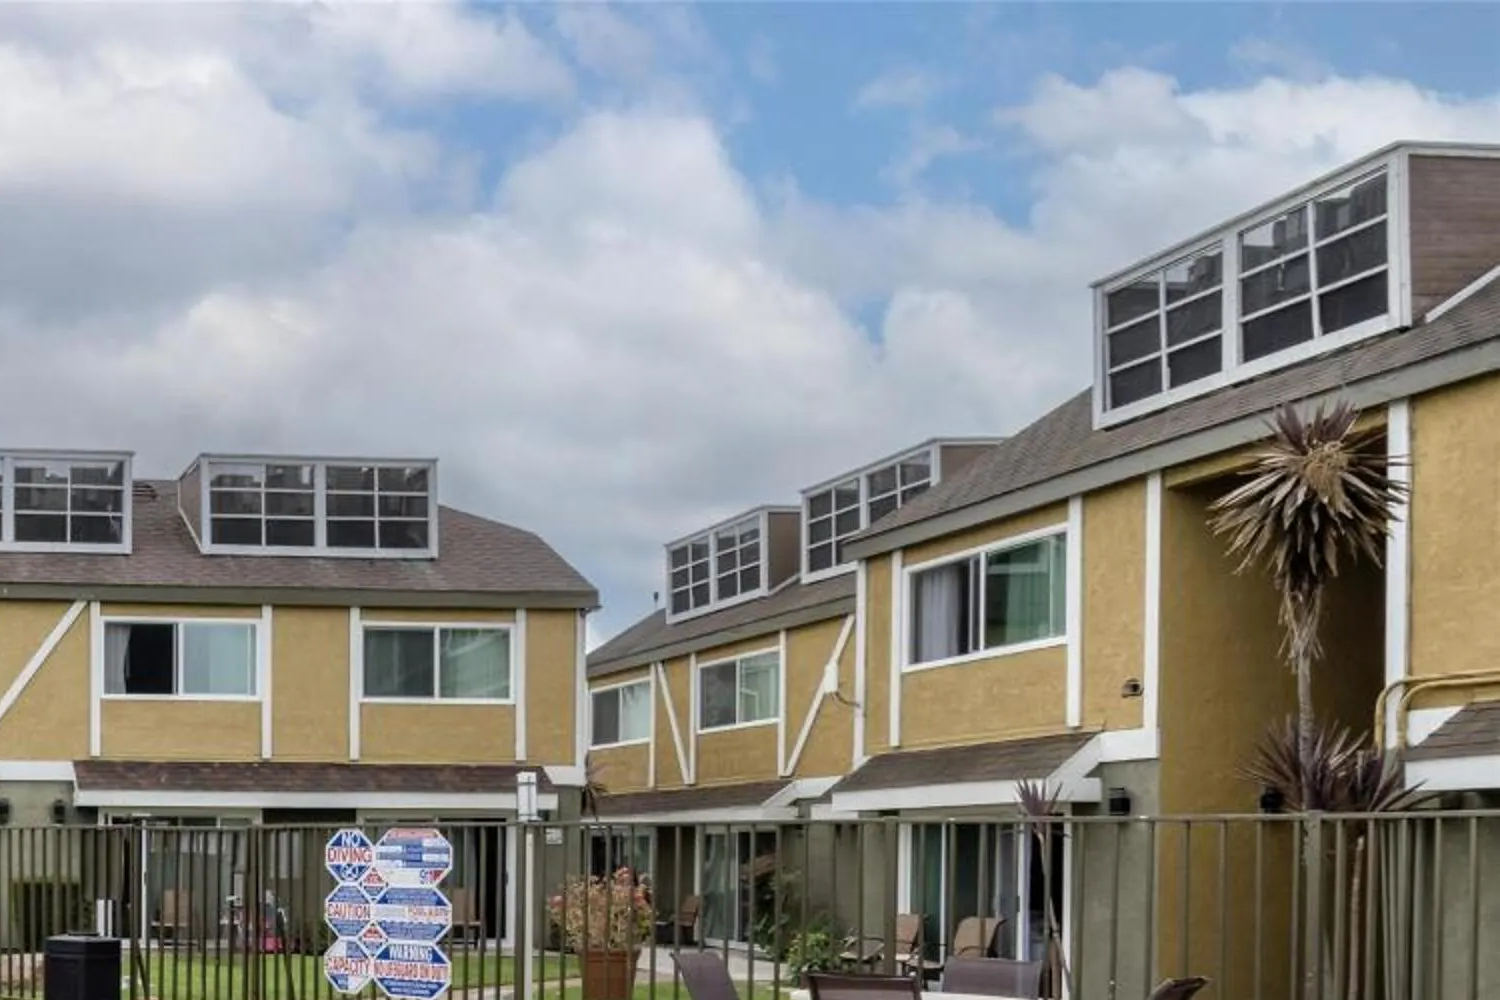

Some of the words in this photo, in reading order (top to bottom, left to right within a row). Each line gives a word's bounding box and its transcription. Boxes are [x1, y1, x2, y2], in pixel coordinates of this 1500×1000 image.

[341, 831, 360, 847] NO
[328, 848, 372, 862] DIVING
[327, 903, 370, 918] CAUTION
[327, 957, 369, 977] CAPACITY
